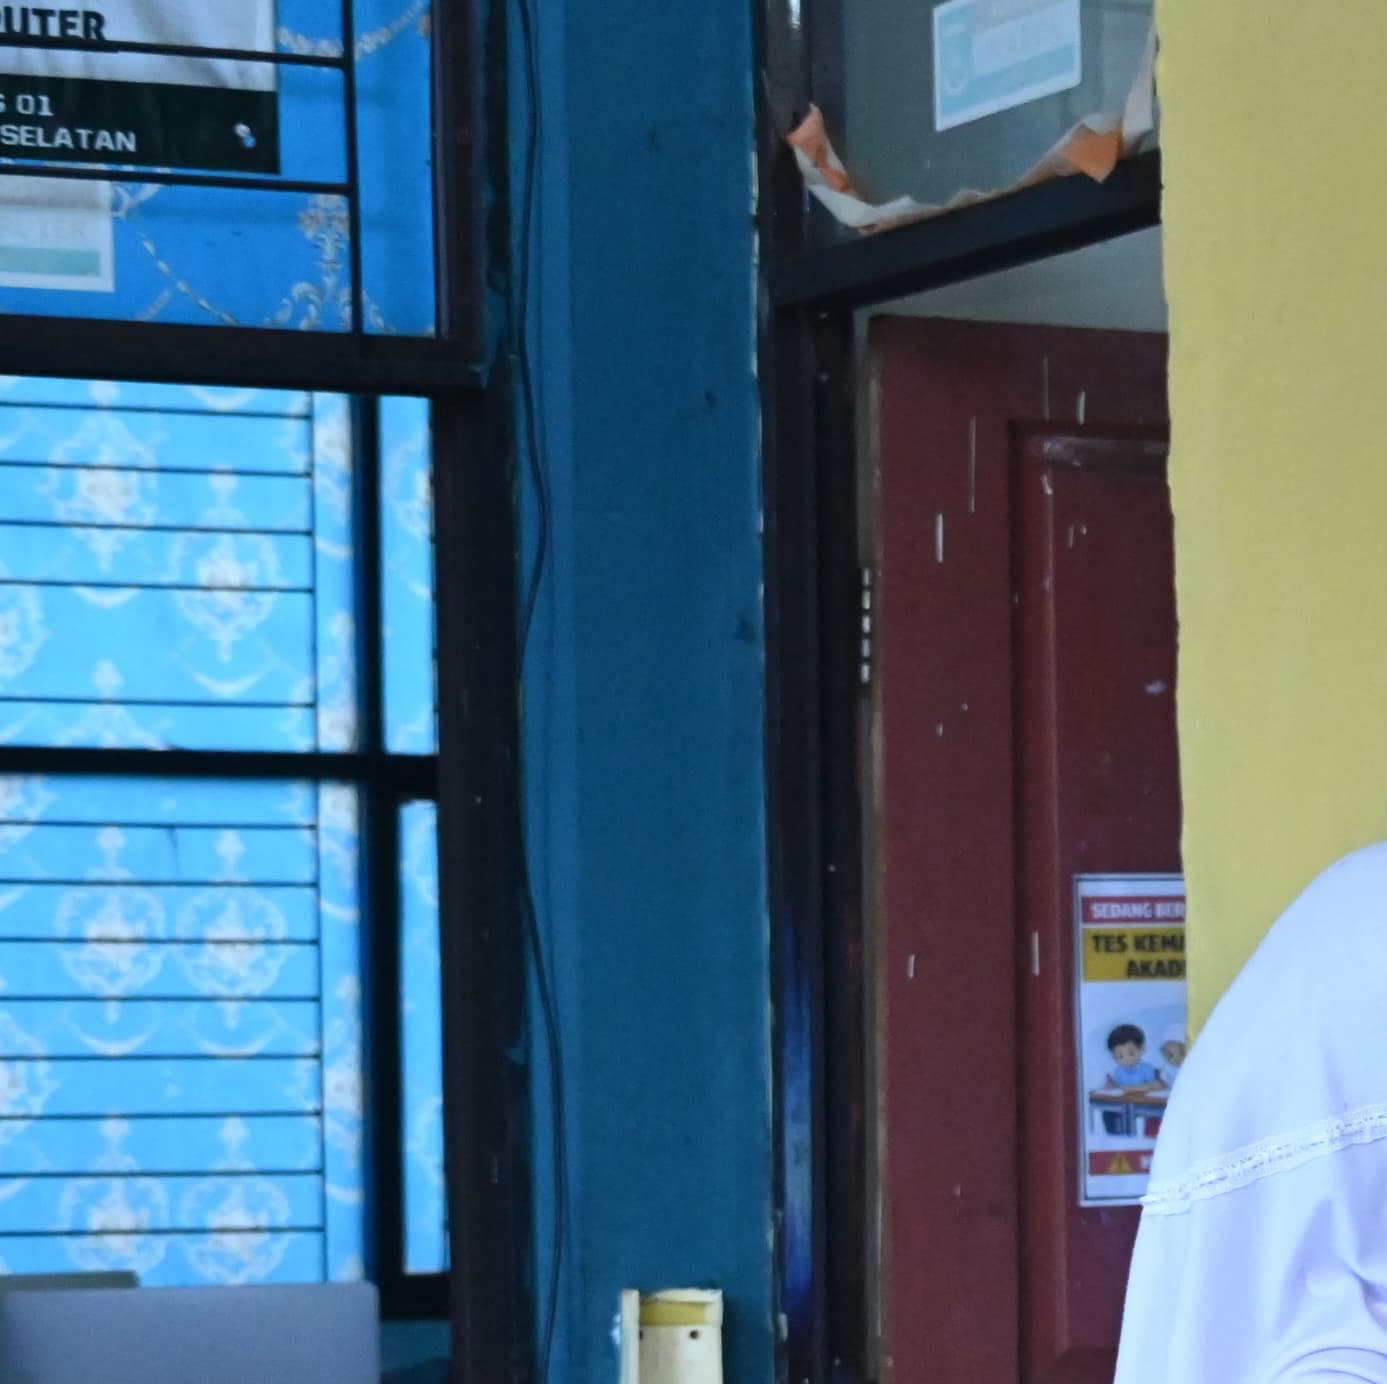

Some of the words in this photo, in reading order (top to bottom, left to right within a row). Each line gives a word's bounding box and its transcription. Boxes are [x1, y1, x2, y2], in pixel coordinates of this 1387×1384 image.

[0, 6, 107, 40] UTER
[16, 93, 54, 117] 01
[0, 124, 137, 152] SELATAN
[1091, 902, 1152, 919] SEDANG
[1092, 934, 1128, 953] TES
